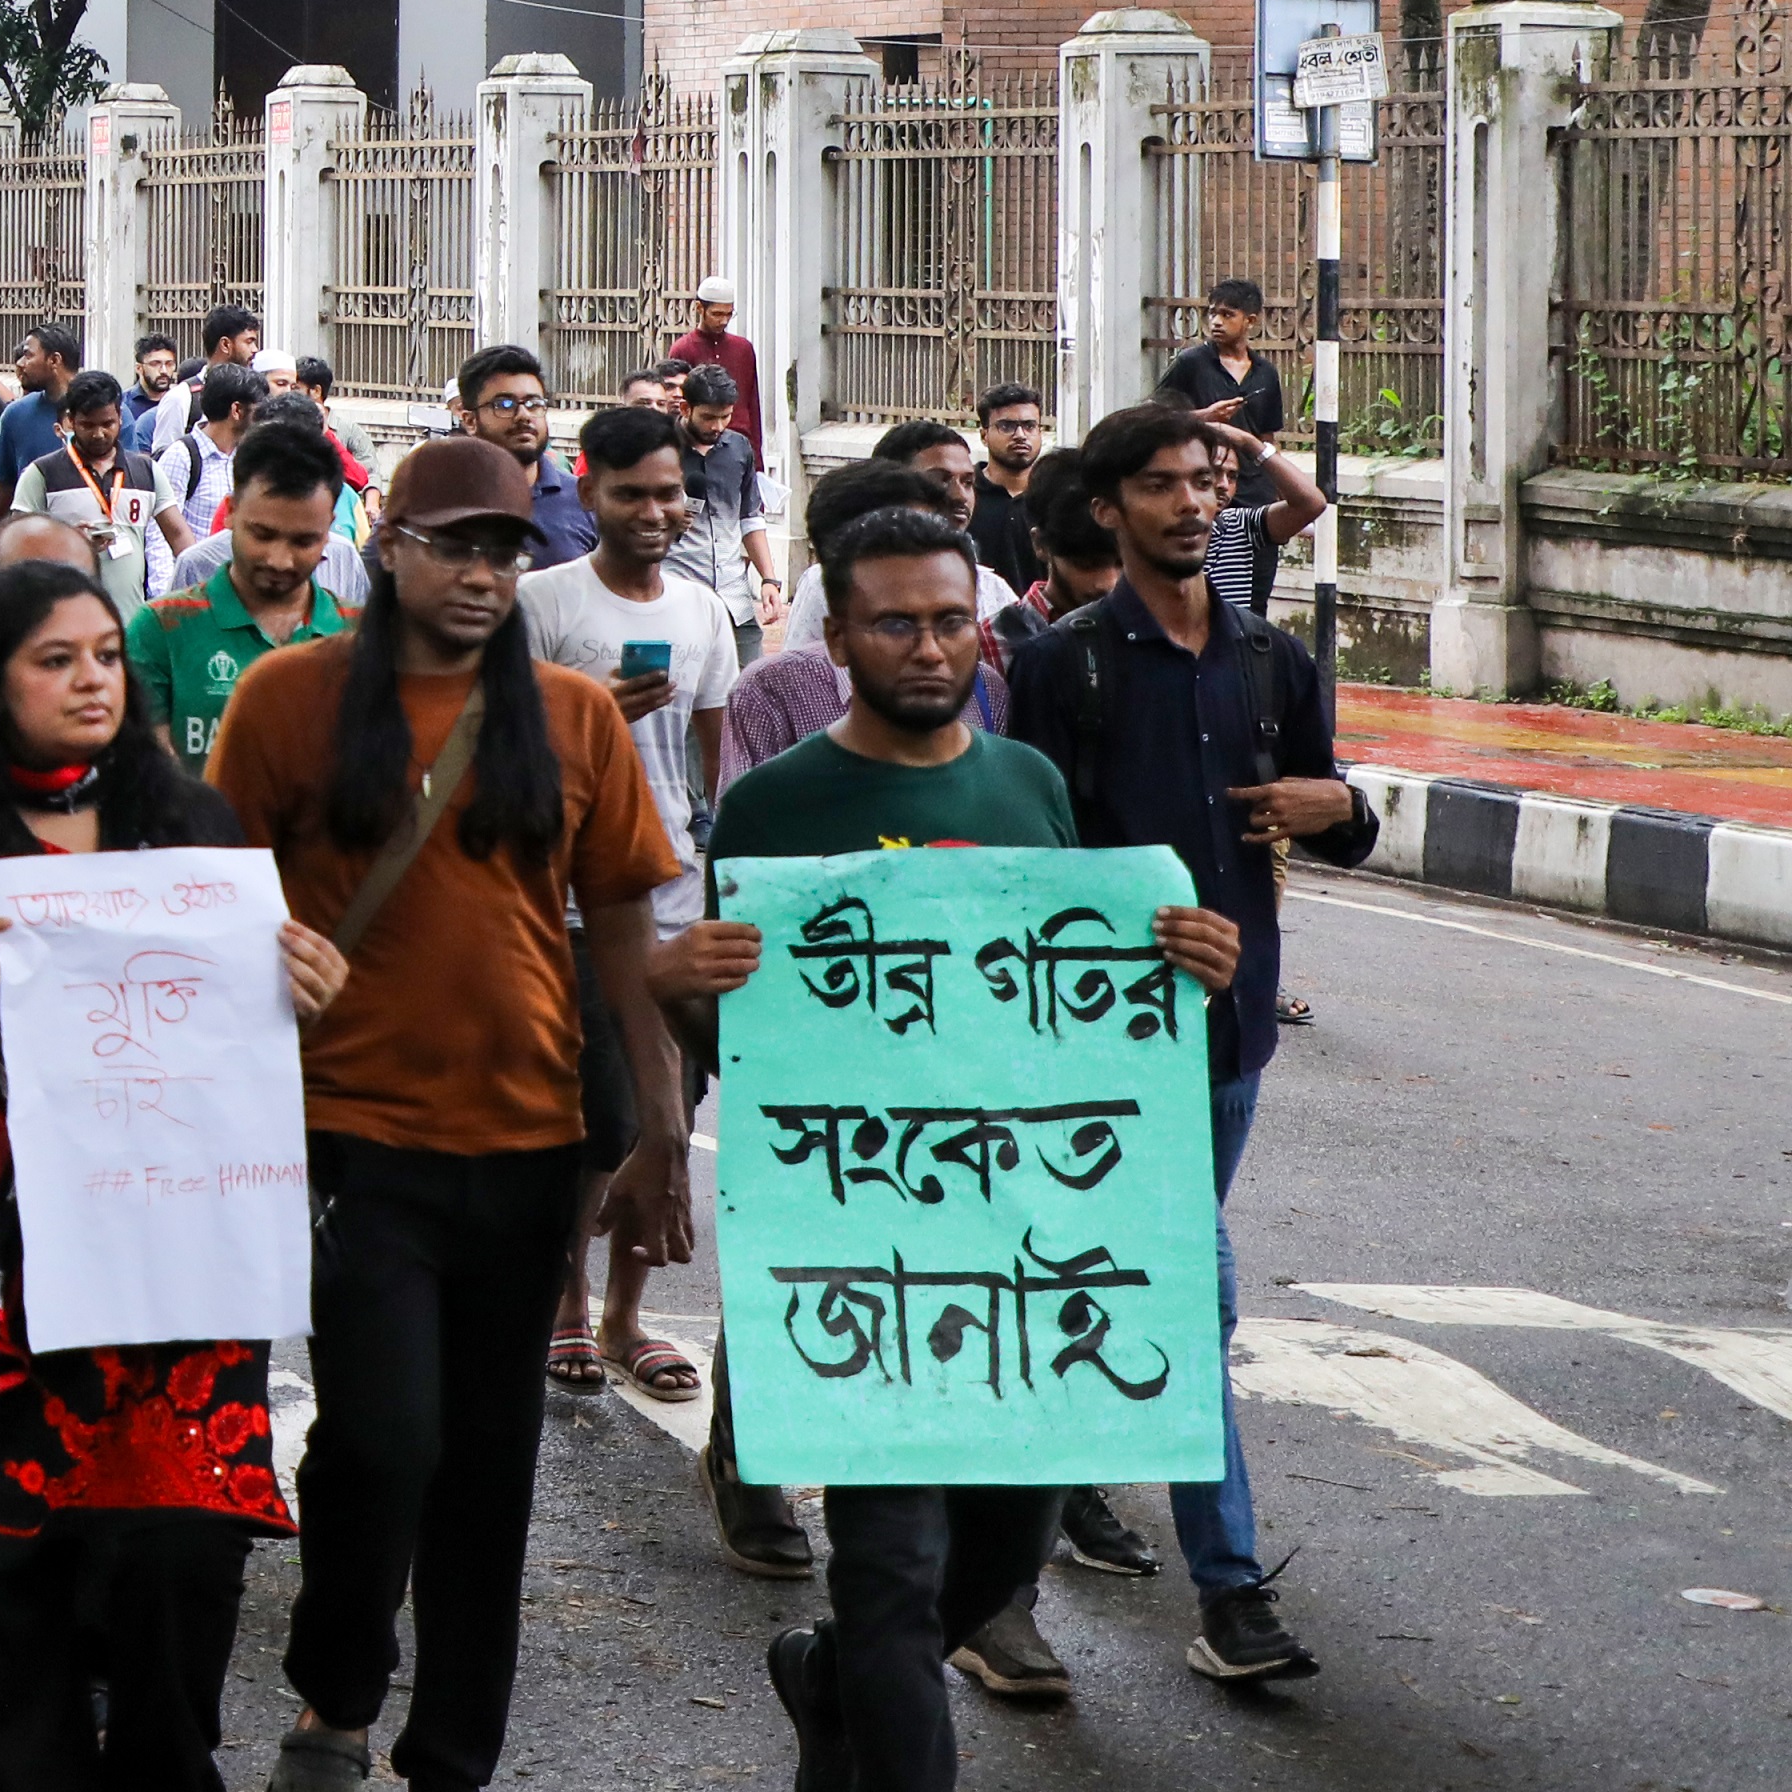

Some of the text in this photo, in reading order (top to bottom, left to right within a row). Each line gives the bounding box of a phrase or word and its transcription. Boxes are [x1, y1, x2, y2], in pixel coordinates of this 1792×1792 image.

[129, 498, 140, 523] 8
[787, 895, 1179, 1042] তীব্র গতির
[758, 1098, 1141, 1207] সংকেত
[768, 1225, 1170, 1402] জানাই
